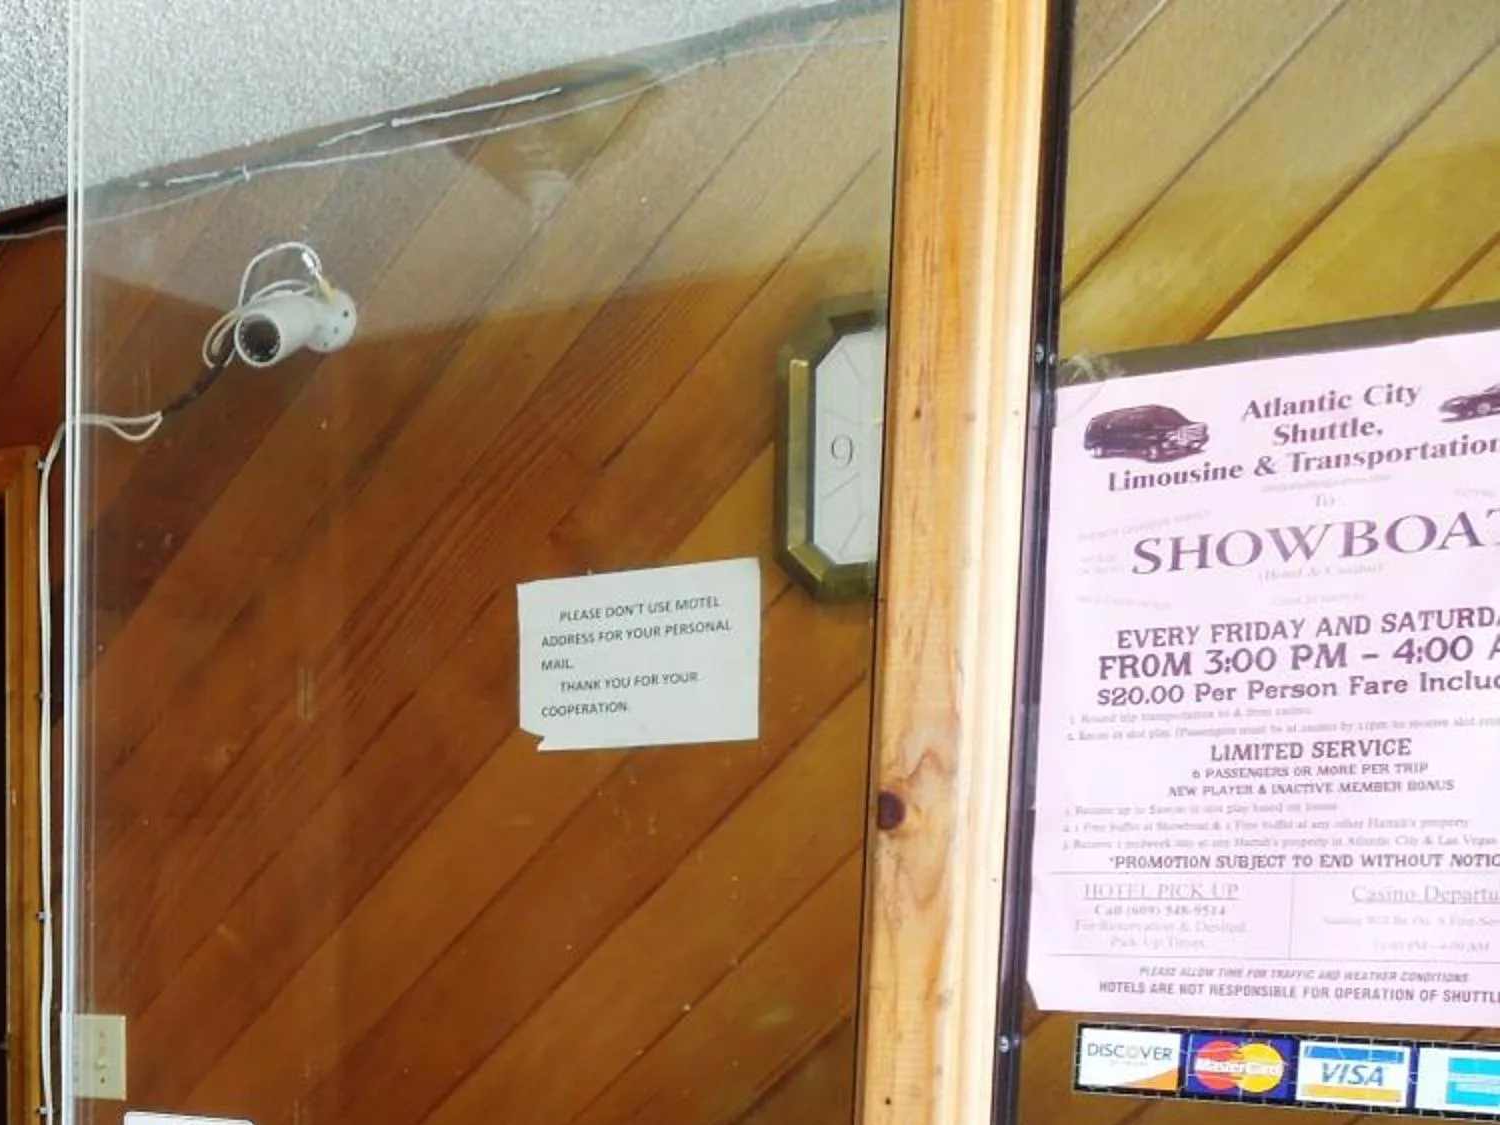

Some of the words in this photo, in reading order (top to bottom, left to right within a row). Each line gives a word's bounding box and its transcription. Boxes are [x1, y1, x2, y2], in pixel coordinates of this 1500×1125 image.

[1242, 390, 1352, 422] Atlantic
[1364, 383, 1422, 408] City
[1273, 417, 1384, 447] Shuttle,
[831, 434, 854, 470] 9
[1108, 463, 1244, 493] Limousine
[1253, 455, 1278, 477] &
[560, 606, 602, 623] PLEASE
[605, 603, 644, 619] DON'T
[648, 600, 673, 615] USE
[675, 595, 721, 612] MOTEL
[541, 630, 596, 648] ADDRESS
[599, 627, 624, 643] FOR
[627, 624, 662, 640] YOUR
[664, 619, 732, 638] PERSONAL
[1117, 625, 1201, 649] EVERY
[1210, 617, 1306, 644] FRIDAY
[1316, 614, 1371, 638] AND
[1381, 605, 1500, 635] SATURD
[541, 658, 575, 673] MAIL.
[1099, 651, 1192, 681] FROM
[1204, 646, 1278, 676] 3:00
[1290, 641, 1348, 671] PM
[1392, 634, 1475, 665] 4:00
[560, 679, 601, 694] THANK
[605, 676, 631, 691] YOU
[634, 674, 659, 688] FOR
[662, 671, 699, 686] YOUR
[1097, 684, 1185, 707] $20.00
[1195, 682, 1238, 703] Per
[1247, 677, 1338, 701] Person
[1349, 674, 1409, 697] Fare
[1211, 741, 1304, 762] LIMITED
[1312, 737, 1413, 760] SERVICE
[1205, 764, 1289, 780] PASSENGERS
[1293, 765, 1312, 777] OR
[1316, 763, 1357, 777] MORE
[1361, 762, 1390, 775] PER
[1394, 761, 1429, 775] TRIP
[1168, 785, 1197, 798] NEW
[1202, 783, 1254, 797] PLAYER
[1271, 781, 1334, 795] INACTIVE
[1338, 780, 1402, 793] MEMBER
[1406, 778, 1456, 792] BONUS
[1215, 854, 1286, 871] SUBJECT
[1292, 854, 1313, 868] TO
[1319, 853, 1353, 868] END
[1361, 853, 1445, 868] WITHOUT
[1099, 979, 1146, 995] HOTELS
[1149, 981, 1174, 995] ARE
[1179, 981, 1205, 996] NOT
[1208, 983, 1297, 1000] RESPONSIBLE
[1303, 985, 1330, 1000] FOR
[1335, 986, 1415, 1002] OPERATION
[1420, 988, 1438, 1002] OF
[1087, 1041, 1174, 1062] DISCOVER
[1320, 1062, 1385, 1087] VISA
